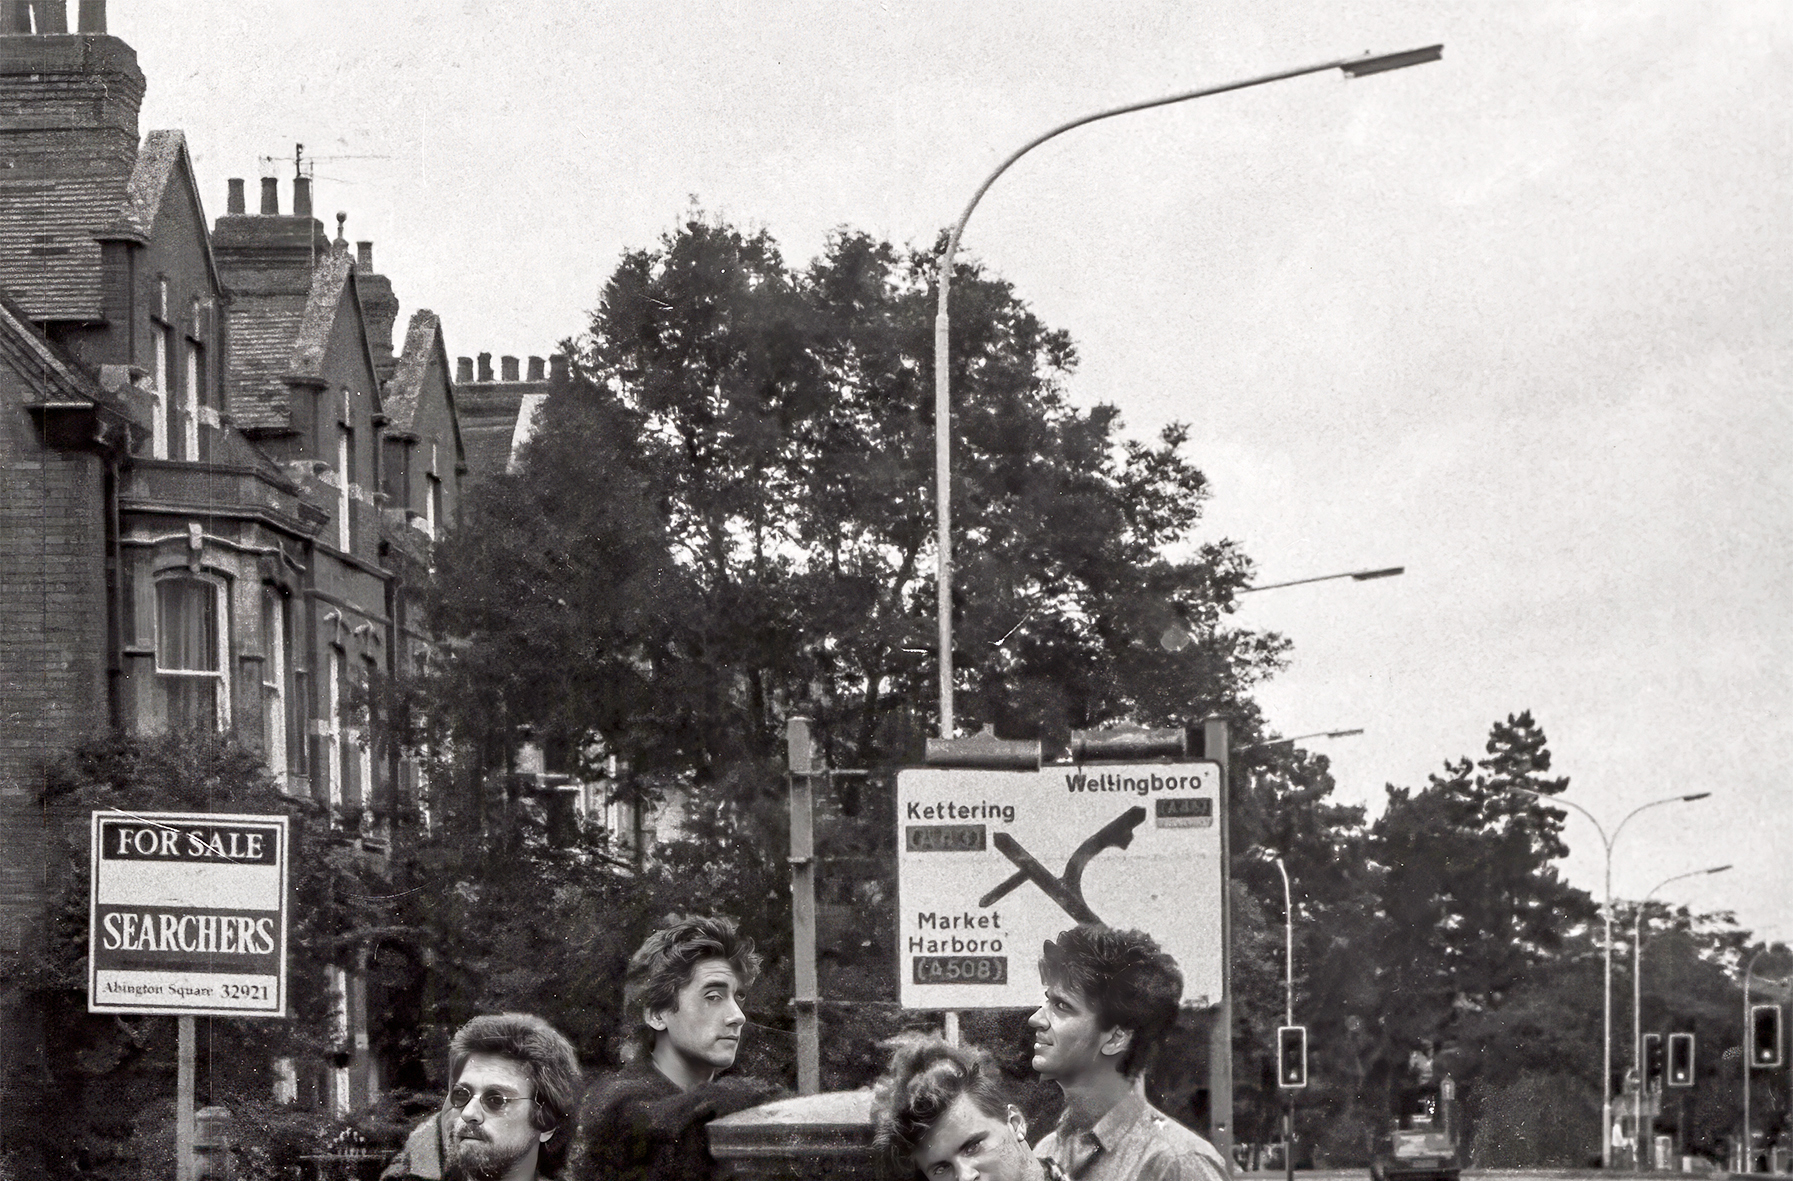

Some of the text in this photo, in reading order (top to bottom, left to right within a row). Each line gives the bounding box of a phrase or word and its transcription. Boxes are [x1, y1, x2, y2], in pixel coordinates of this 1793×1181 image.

[907, 800, 1015, 823] Kettering
[116, 828, 264, 859] FOR SALE
[918, 911, 1001, 931] Market
[102, 912, 275, 955] SEARCHERS
[102, 981, 270, 1001] Abington Square 32921
